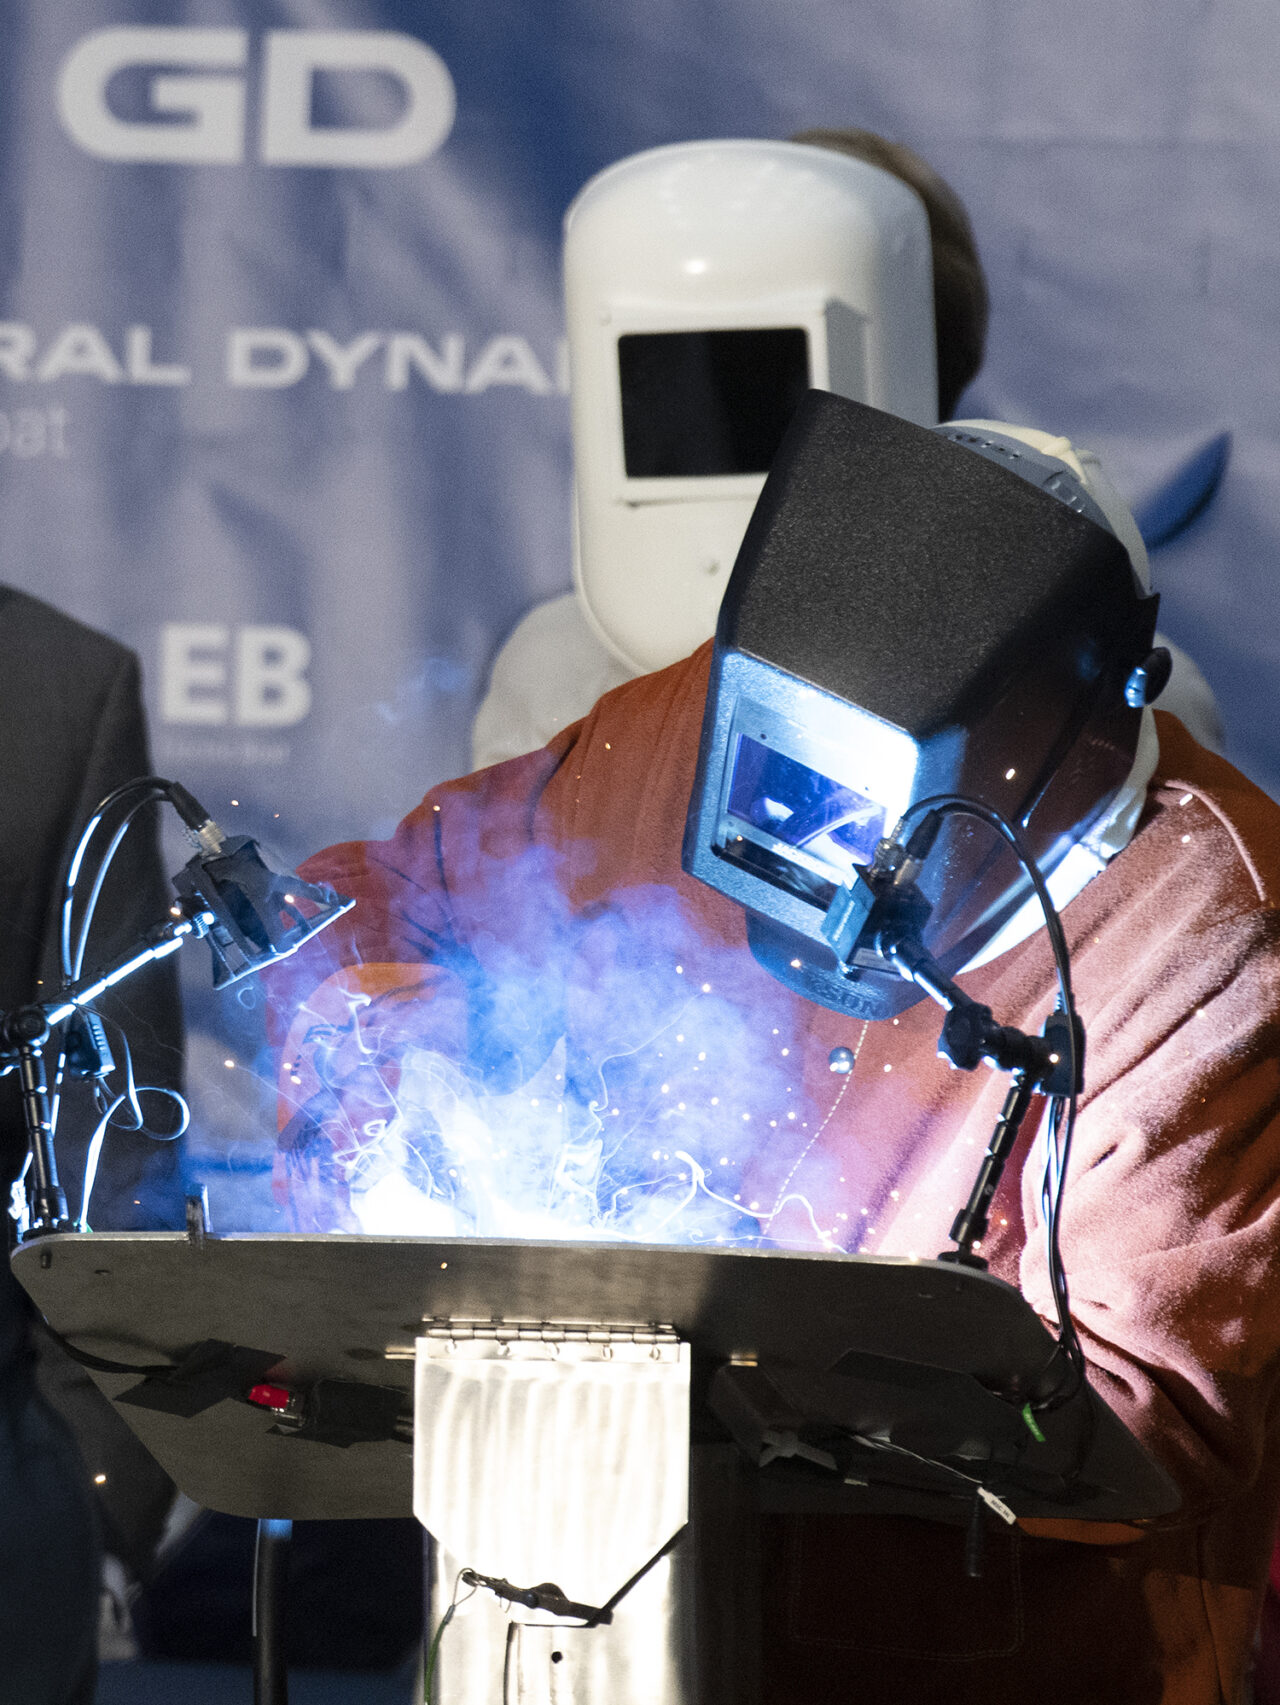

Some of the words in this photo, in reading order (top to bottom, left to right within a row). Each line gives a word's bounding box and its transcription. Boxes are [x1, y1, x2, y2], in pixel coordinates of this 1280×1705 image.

[58, 26, 456, 169] GD
[227, 325, 570, 396] DYNA
[161, 622, 312, 727] EB
